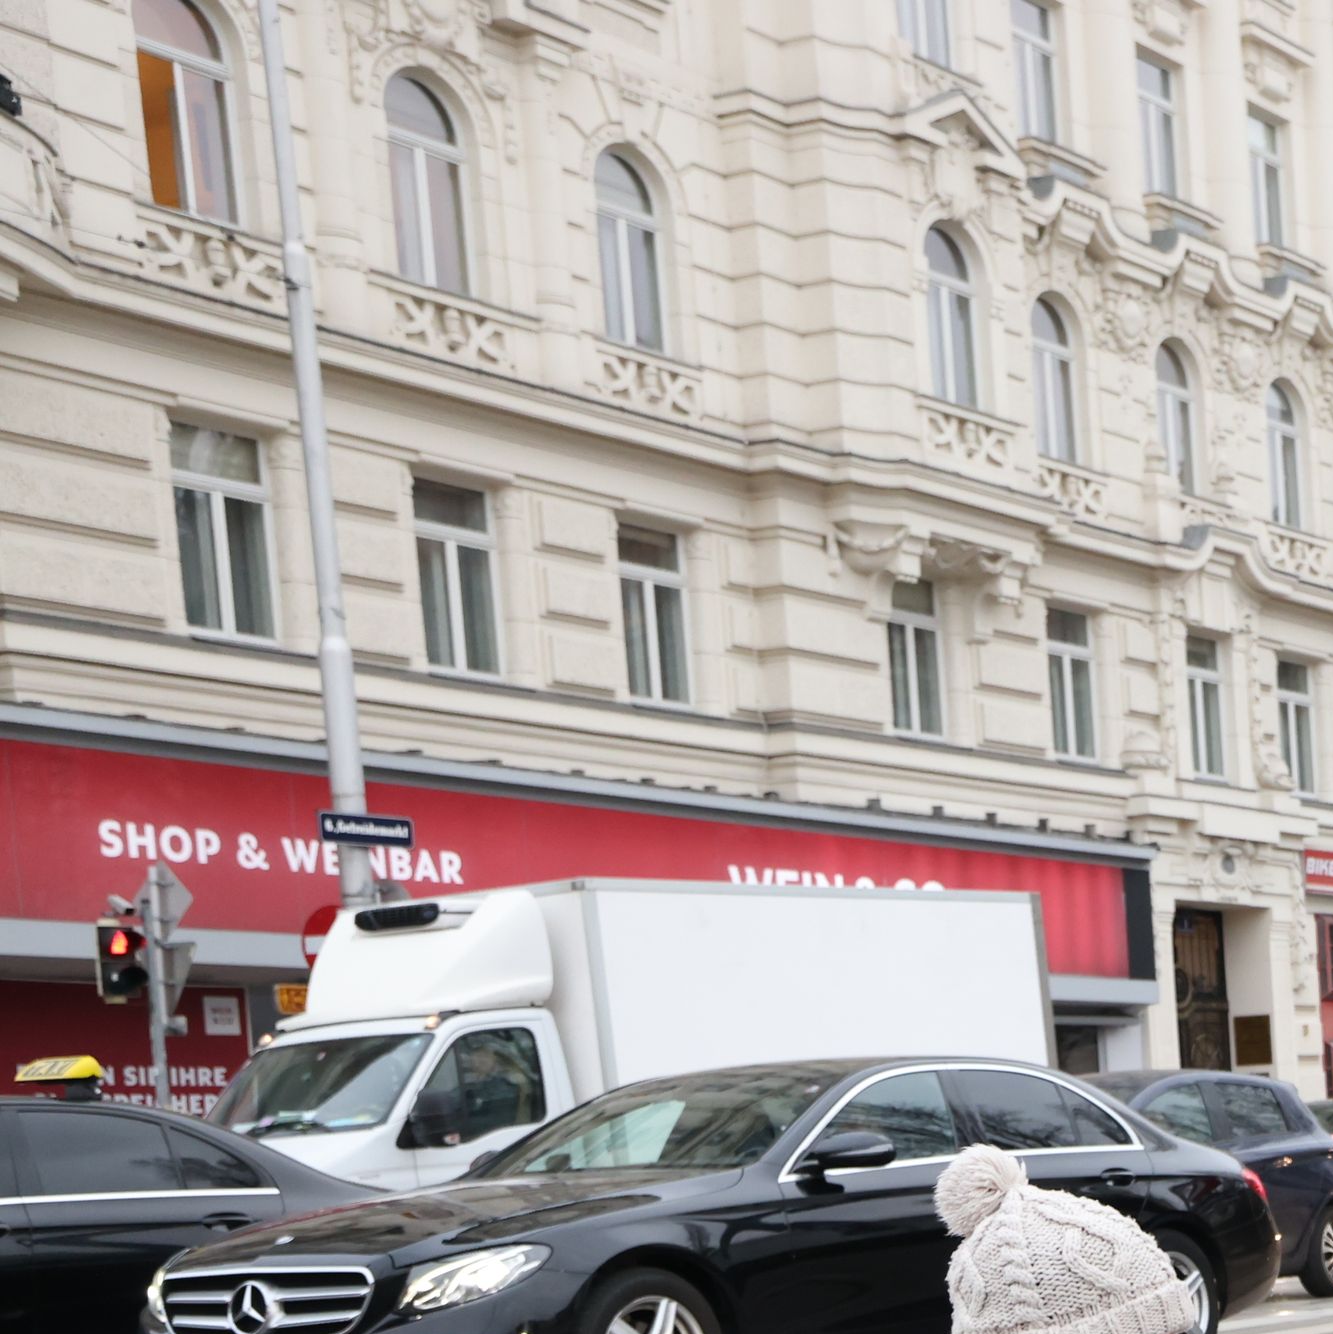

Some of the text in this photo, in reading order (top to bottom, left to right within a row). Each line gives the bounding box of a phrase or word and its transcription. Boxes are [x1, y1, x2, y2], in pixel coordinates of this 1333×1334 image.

[98, 819, 464, 885] SHOP & WENBAR
[172, 1066, 228, 1087] IHRE
